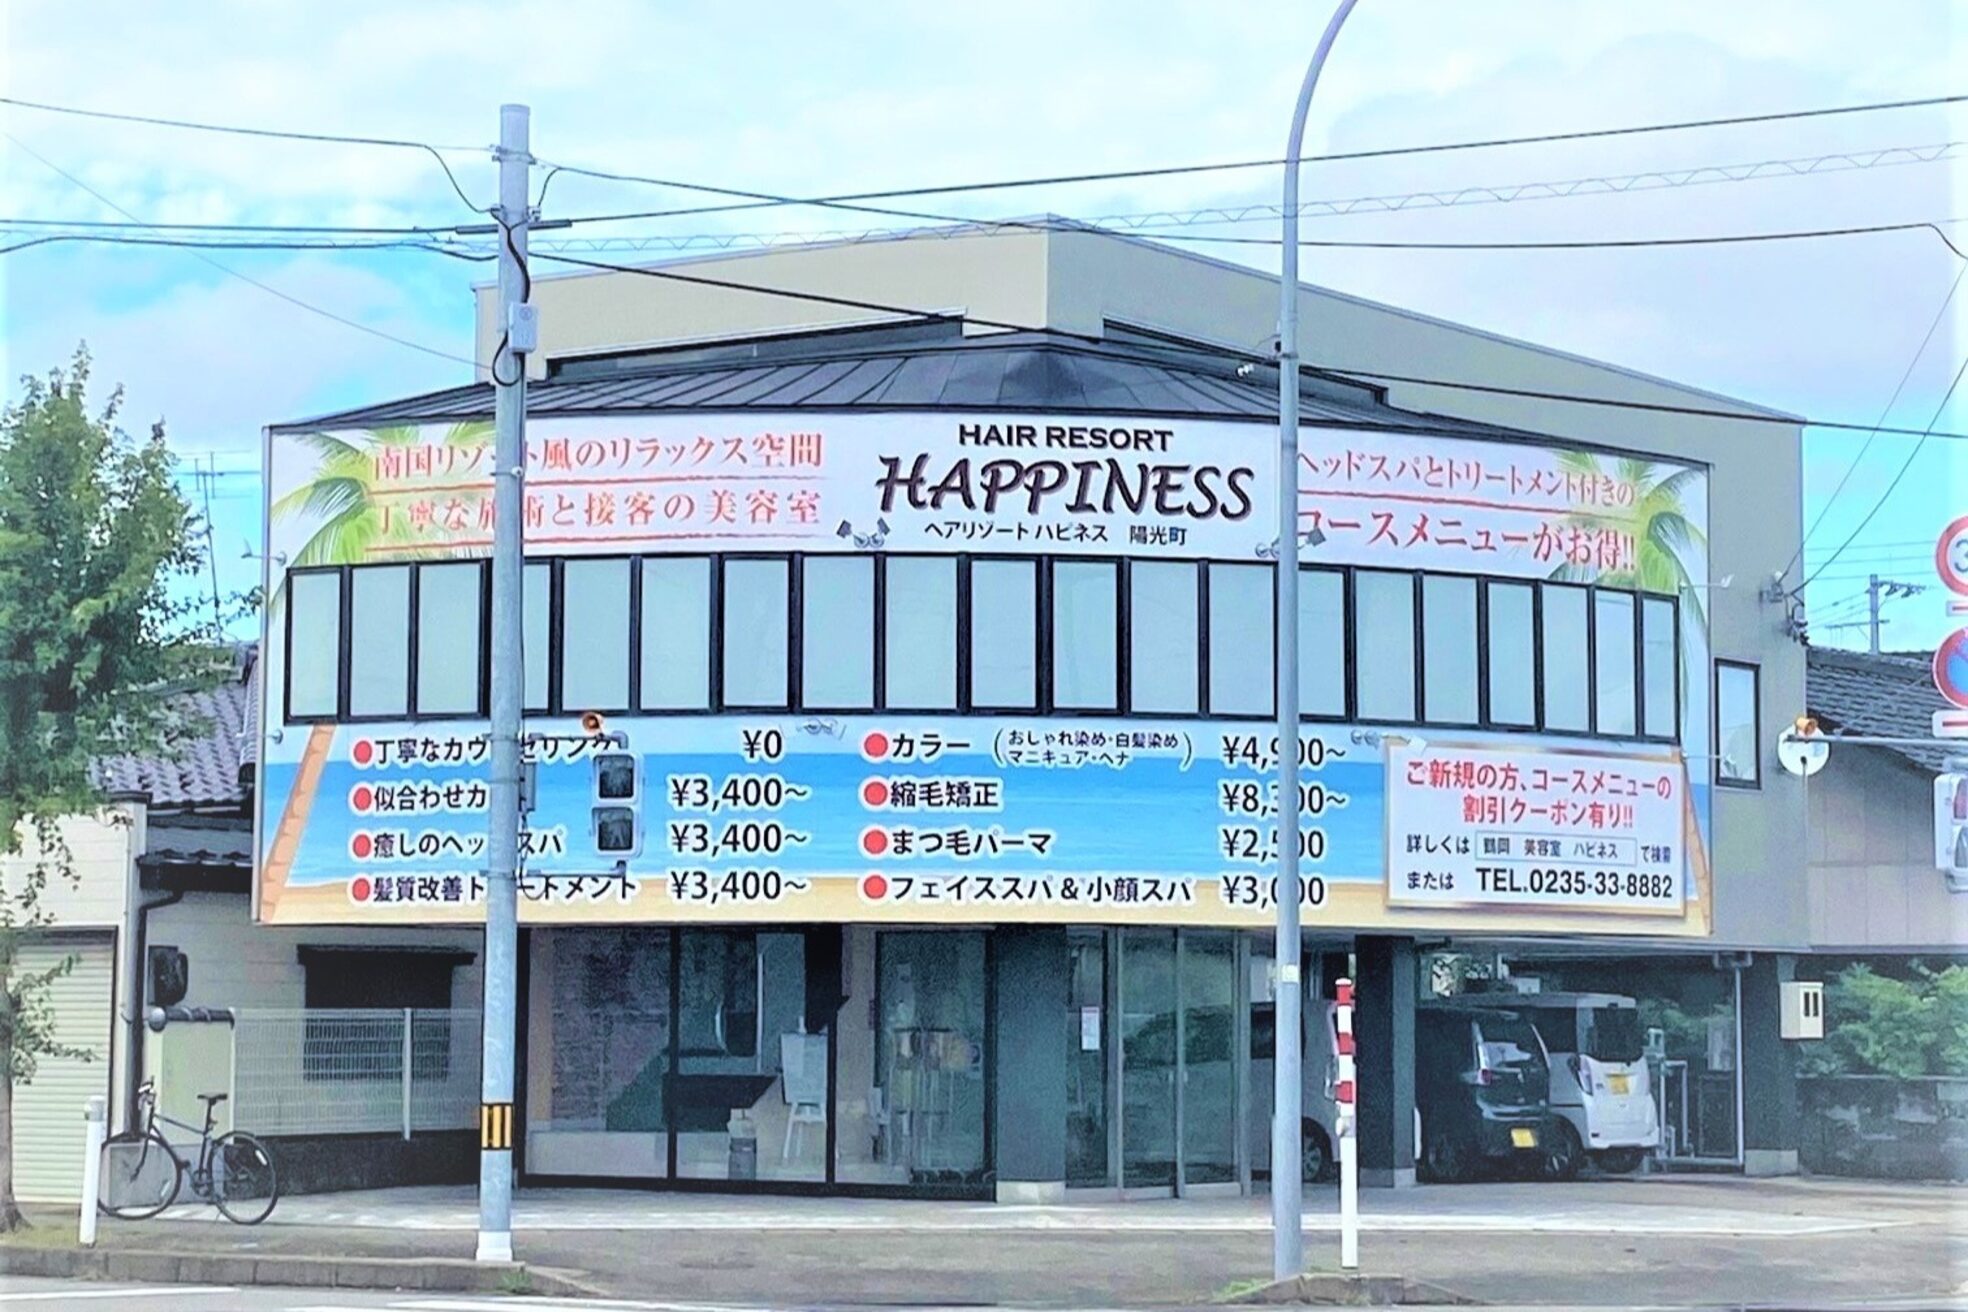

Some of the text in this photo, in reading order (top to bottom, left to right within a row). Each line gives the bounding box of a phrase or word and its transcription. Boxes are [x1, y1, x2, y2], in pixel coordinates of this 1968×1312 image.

[959, 424, 1174, 451] HAIR RESORT
[375, 433, 822, 480] 南国リゾト風のリラックス空間
[876, 452, 1255, 521] HAPPINESS
[1129, 526, 1187, 546] 陽光町
[375, 738, 612, 764] 丁寧なカウセリン
[743, 730, 783, 758] ¥0
[891, 733, 970, 757] カラー
[1407, 759, 1672, 799] ご新規の方、コースメニューの
[890, 780, 999, 808] 縮毛矯正
[1463, 795, 1634, 828] 割引クーポン有り!!
[373, 829, 563, 859] 癒しのヘッスパ
[892, 829, 1052, 855] まつ毛パーマ
[1406, 835, 1470, 855] 詳しくは
[1524, 838, 1561, 858] 美容室
[373, 876, 636, 904] 髪質改善トートメント
[1407, 871, 1455, 891] または
